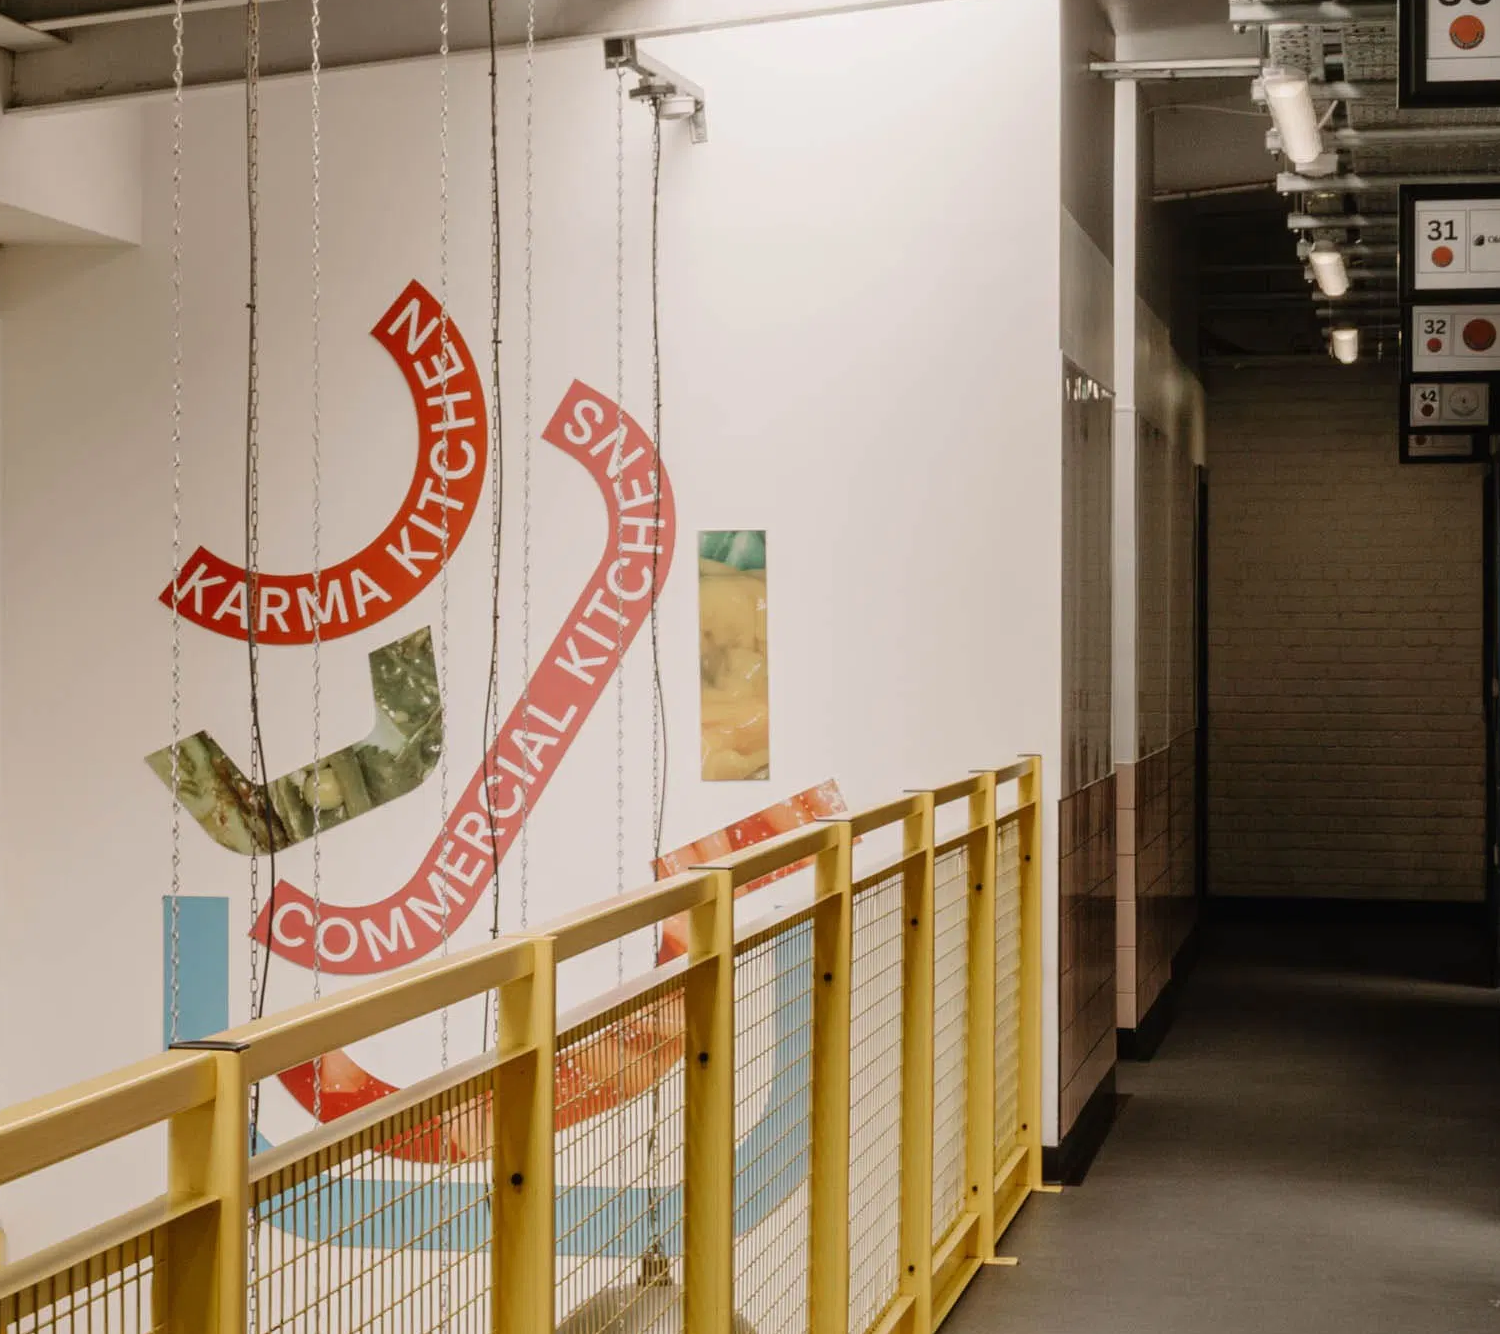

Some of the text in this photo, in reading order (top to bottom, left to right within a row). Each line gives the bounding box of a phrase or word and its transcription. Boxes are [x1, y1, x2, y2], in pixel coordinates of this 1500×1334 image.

[1427, 220, 1458, 242] 31
[1424, 319, 1446, 335] 32
[178, 297, 476, 632] KARMA KITCHEN
[271, 399, 666, 963] COMMERCIAL KITCHENS
